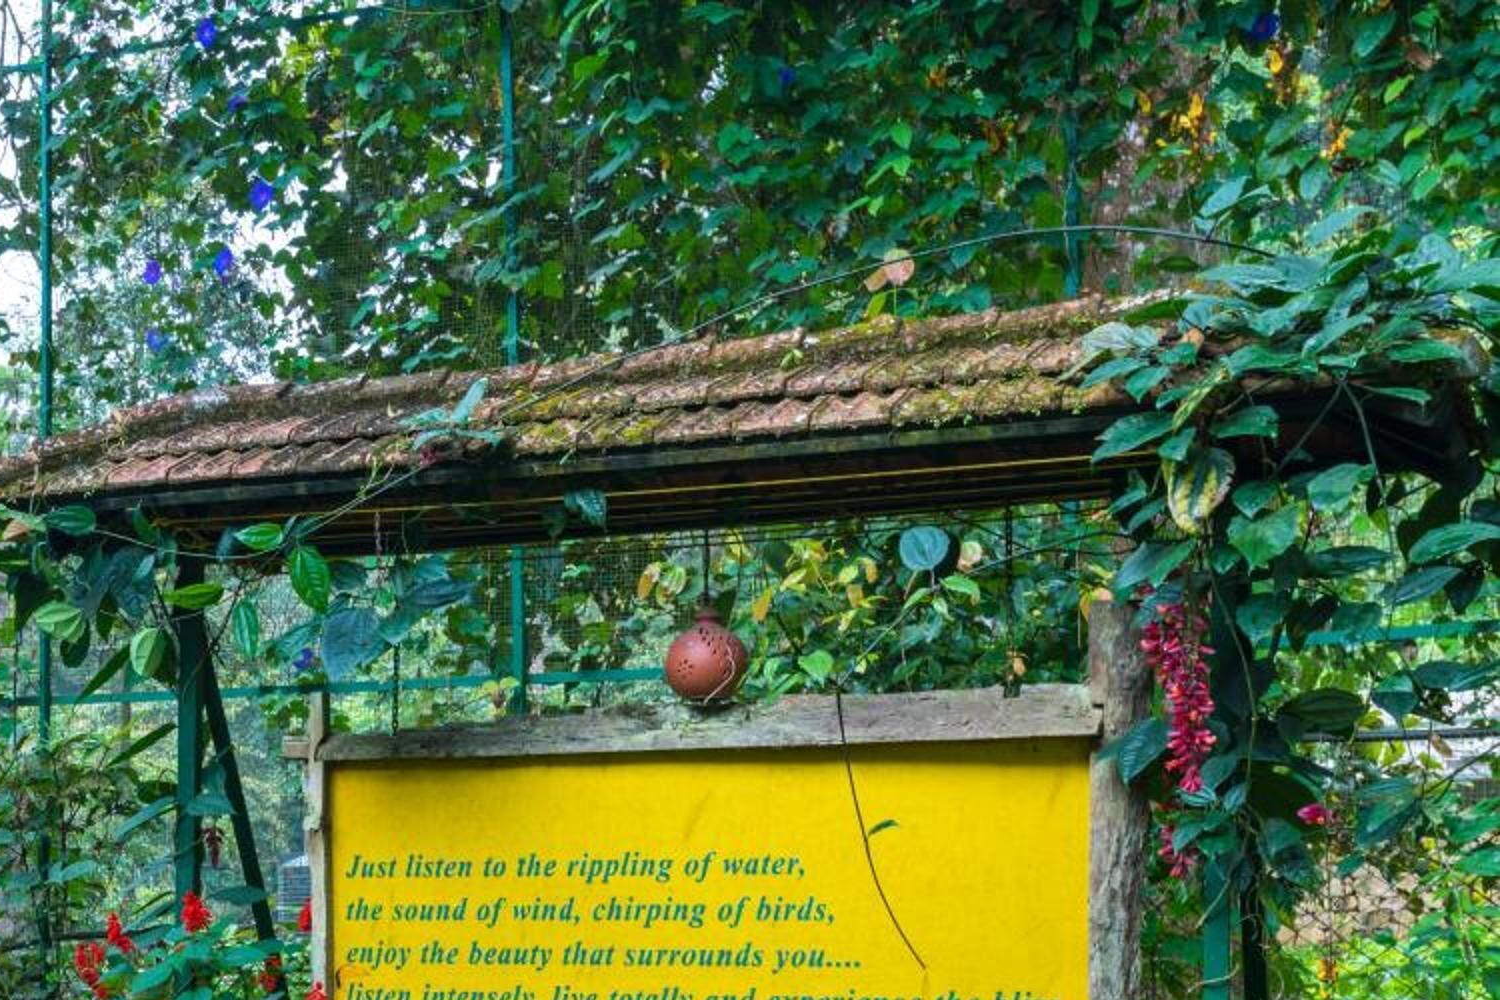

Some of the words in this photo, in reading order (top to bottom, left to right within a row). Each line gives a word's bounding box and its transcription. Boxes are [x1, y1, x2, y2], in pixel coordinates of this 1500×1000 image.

[345, 855, 399, 880] Just
[404, 855, 472, 879] listen
[483, 859, 507, 879] to
[514, 851, 558, 879] the
[565, 851, 675, 885] rippling
[683, 852, 718, 885] of
[722, 855, 805, 879] water,
[345, 898, 383, 923] the
[392, 896, 469, 923] sound
[476, 896, 508, 929] of
[511, 896, 583, 924] wind,
[590, 895, 707, 929] chirping
[717, 896, 753, 929] of
[754, 896, 835, 924] birds,
[345, 943, 412, 970] enjoy
[417, 940, 459, 967] the
[467, 939, 555, 972] beauty
[562, 940, 617, 968] that
[625, 940, 765, 969] surrounds
[771, 948, 862, 974] you....
